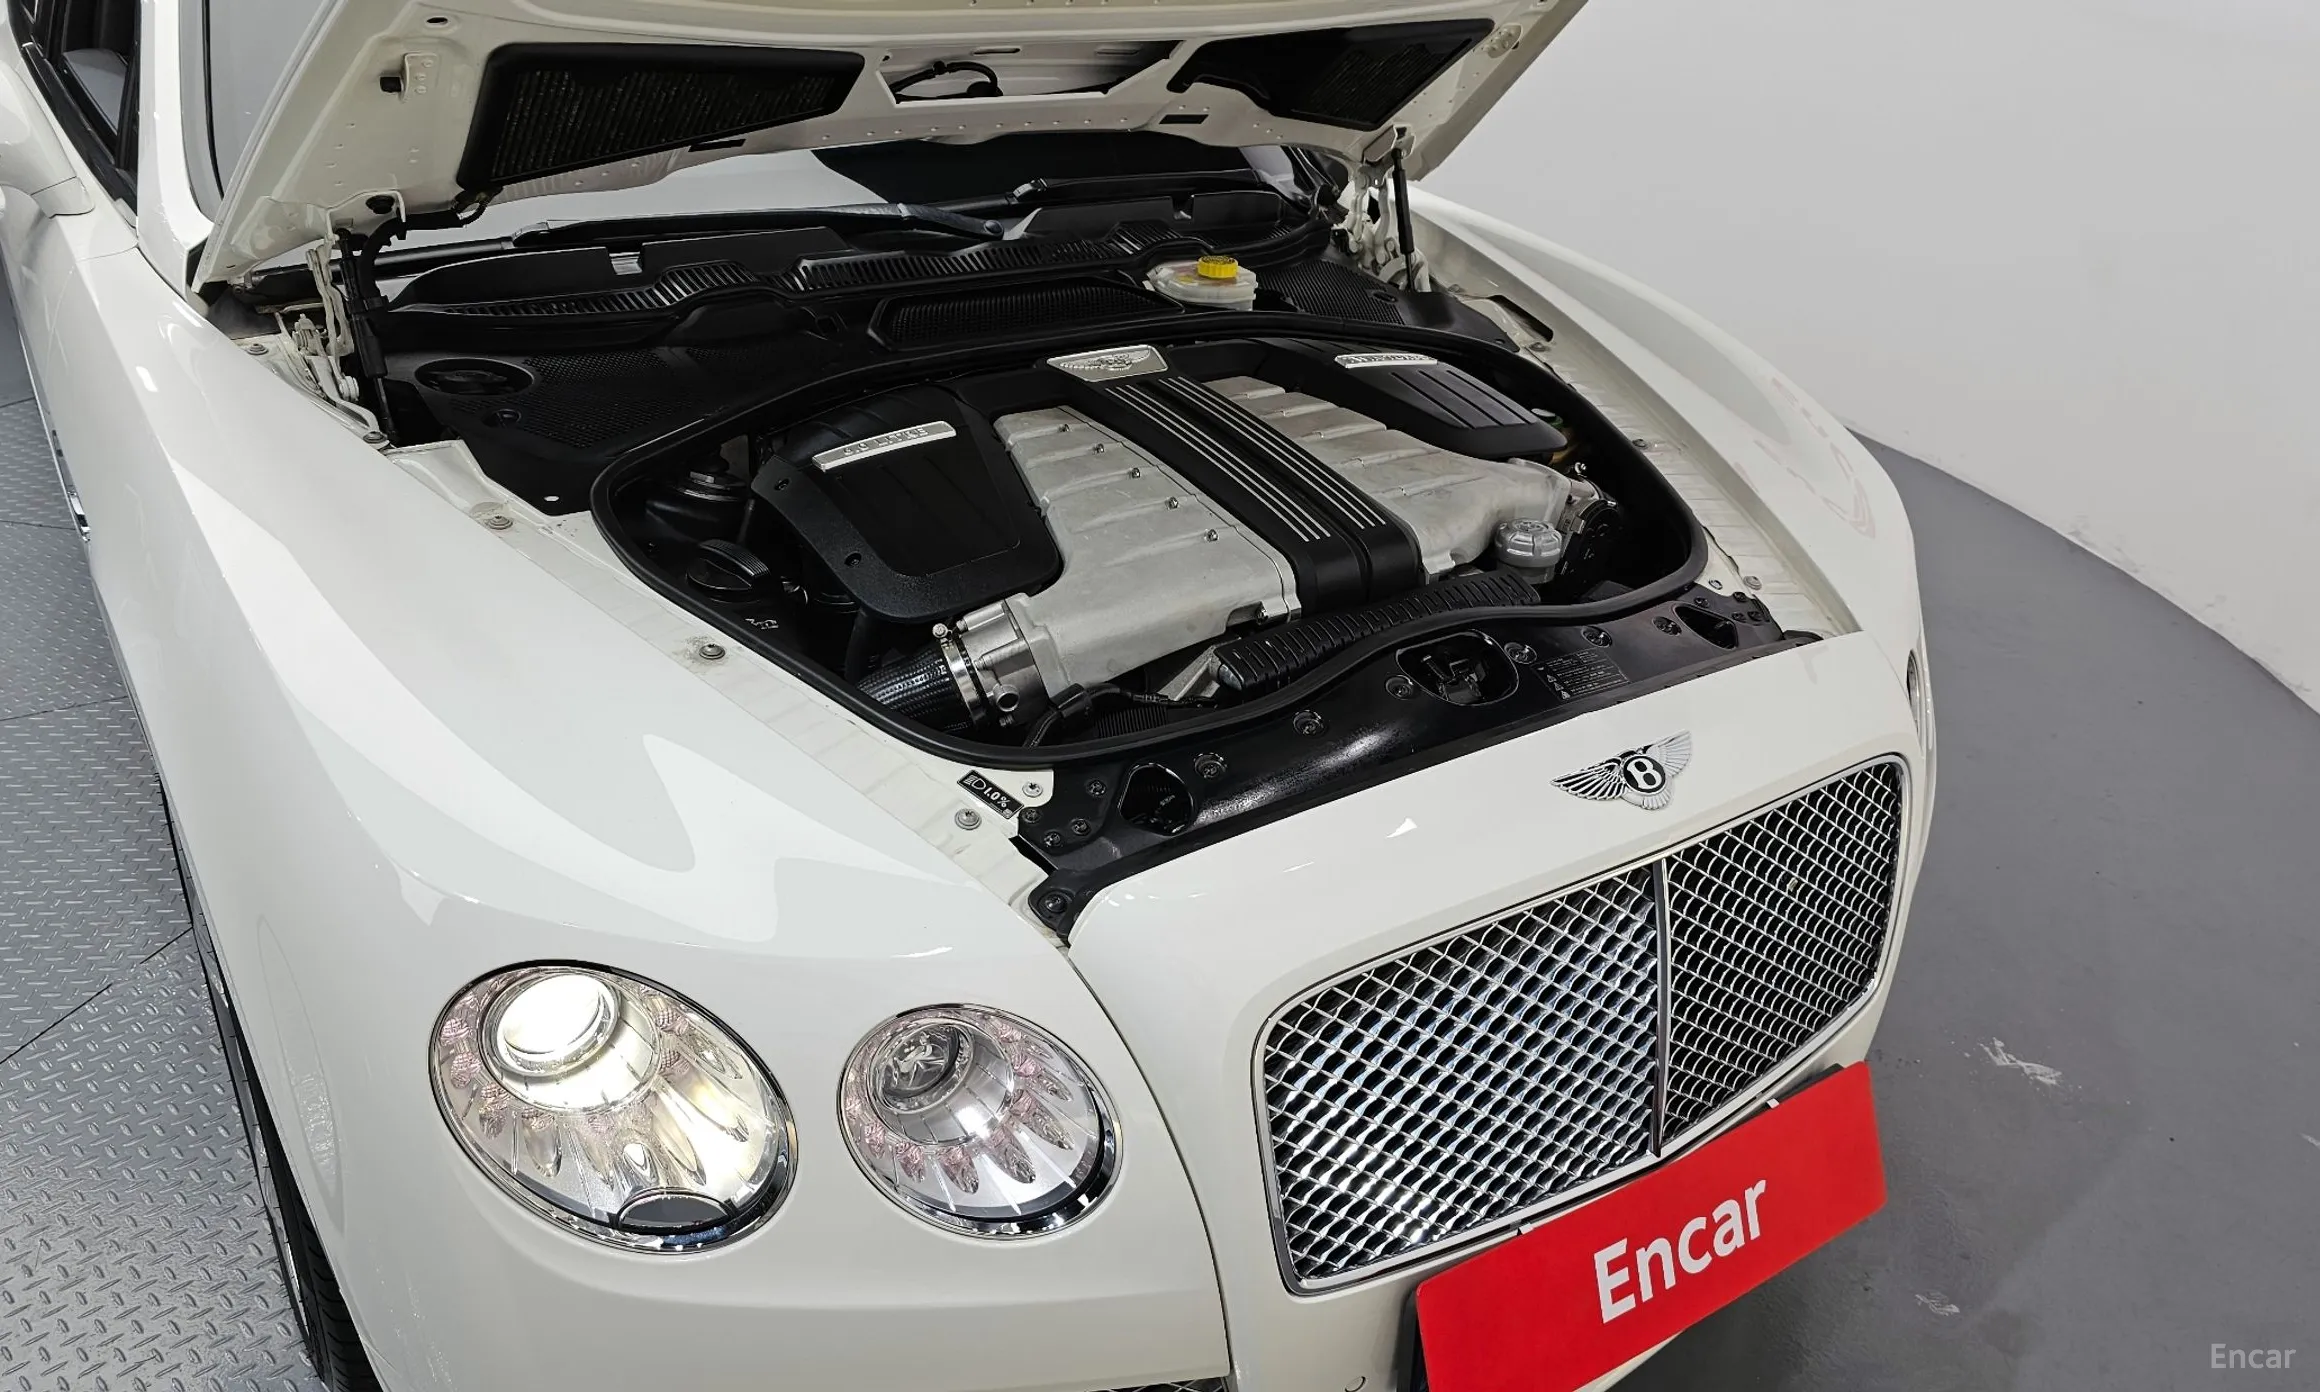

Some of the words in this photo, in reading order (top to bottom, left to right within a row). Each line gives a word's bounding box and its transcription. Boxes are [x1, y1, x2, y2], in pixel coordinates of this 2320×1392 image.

[873, 427, 929, 447] LITRE
[1626, 757, 1662, 790] B
[983, 787, 1010, 808] 1.0%
[1593, 1179, 1767, 1325] Encar
